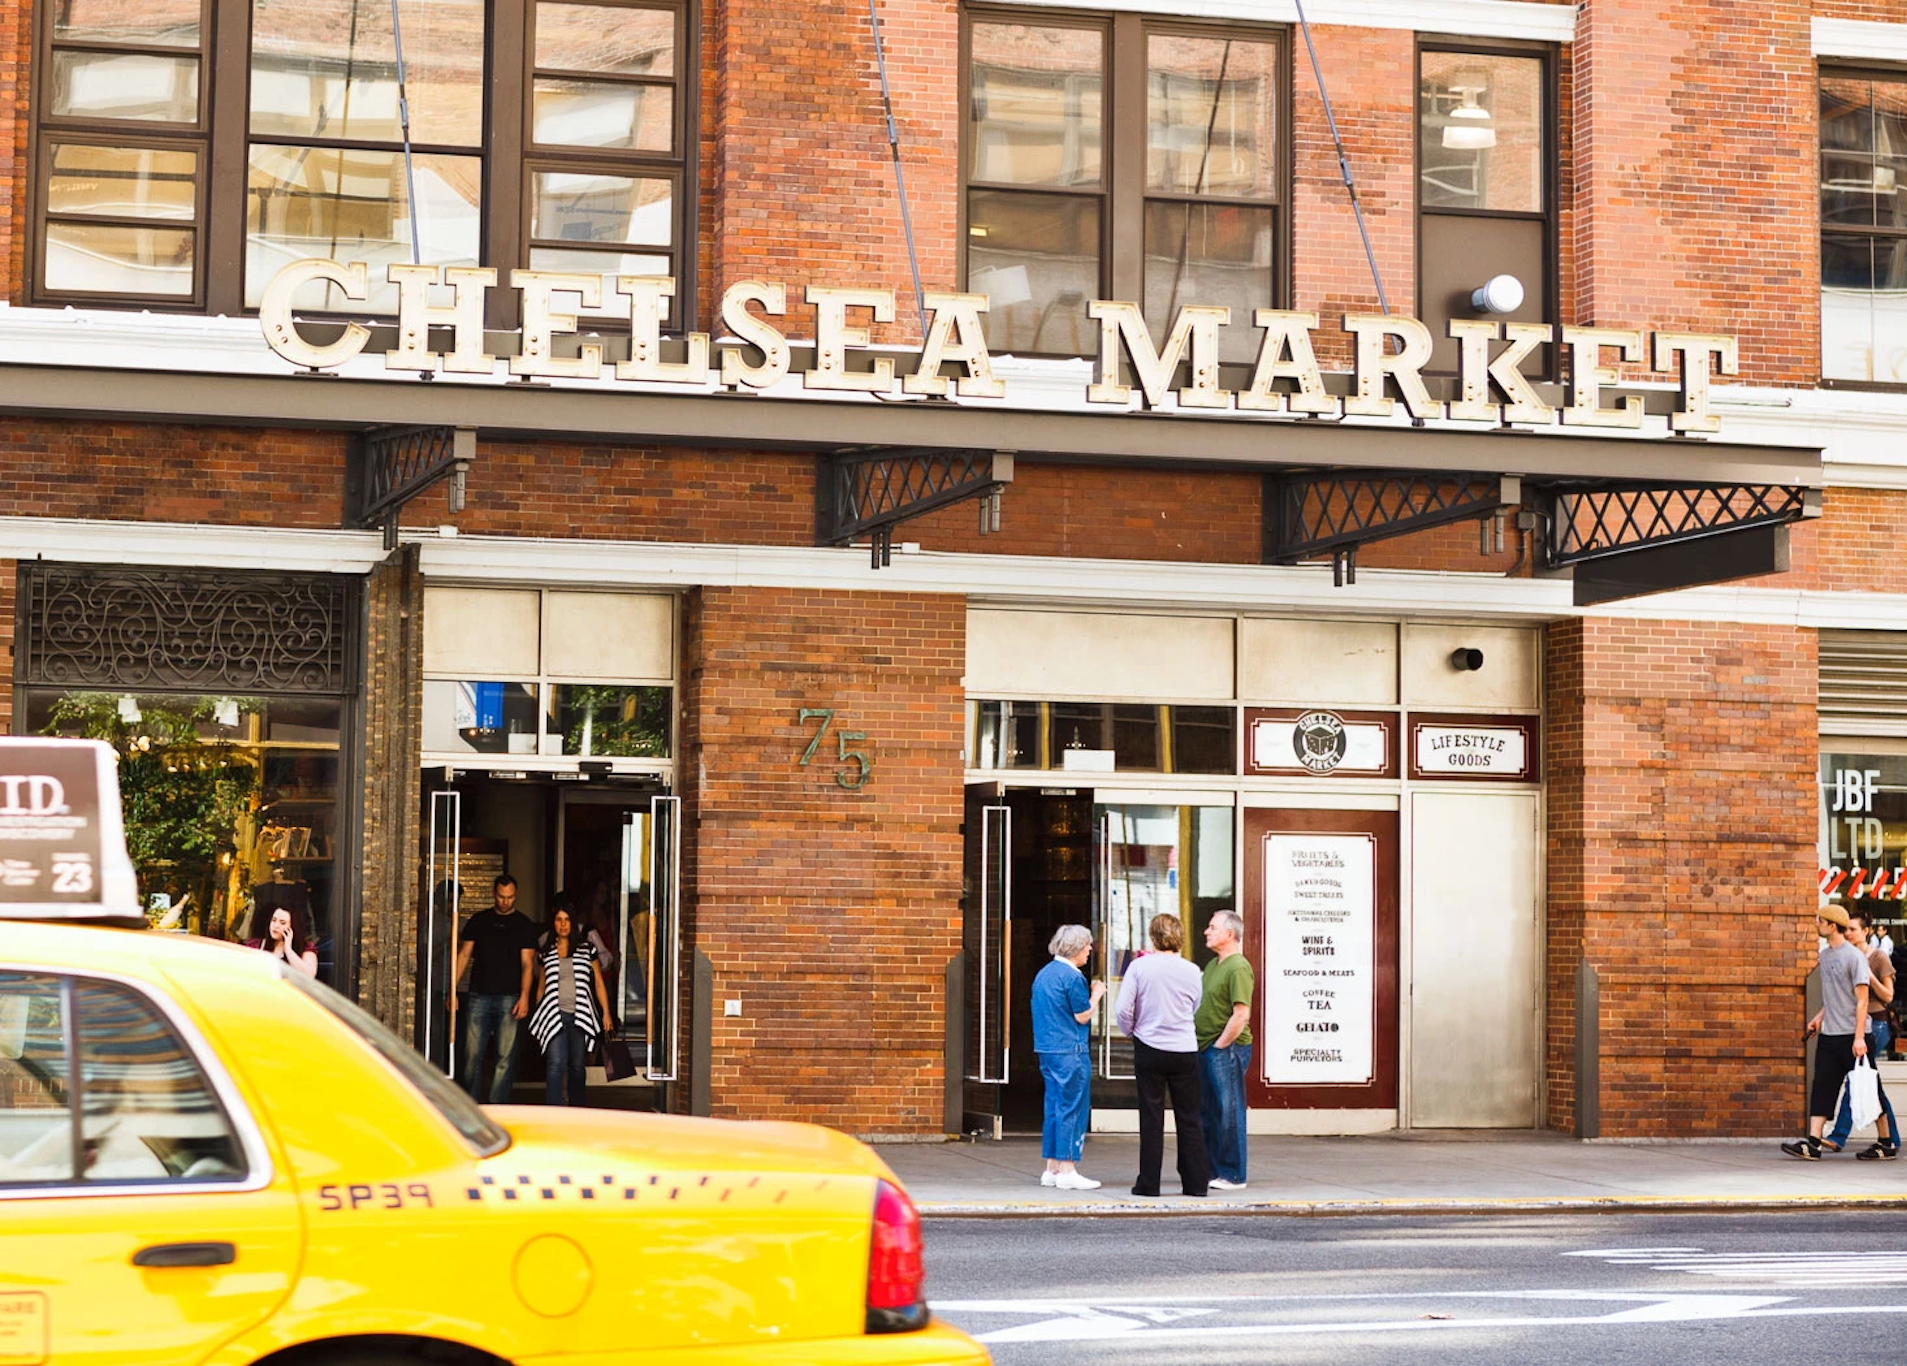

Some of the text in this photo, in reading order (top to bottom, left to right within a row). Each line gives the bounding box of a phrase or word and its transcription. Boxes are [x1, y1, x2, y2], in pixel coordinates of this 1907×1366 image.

[258, 258, 1740, 433] CHELSEA MARKET
[1299, 713, 1342, 735] CHELSEA
[799, 708, 870, 789] 75
[1431, 734, 1505, 752] LIFESTYLE
[1300, 751, 1341, 770] MARKET
[1448, 753, 1491, 767] GOODS
[1832, 769, 1881, 812] JBF
[1830, 816, 1884, 860] LTD
[1291, 851, 1329, 859] FRUITS
[1291, 860, 1345, 868] VEGETABLES
[51, 861, 93, 893] 23
[1302, 936, 1333, 945] WINE &
[1303, 946, 1335, 956] SPIRITS
[1283, 969, 1320, 977] SEAFOOD
[1302, 989, 1336, 998] COFFEE
[1308, 1000, 1332, 1010] TEA
[1296, 1022, 1339, 1033] GELATO
